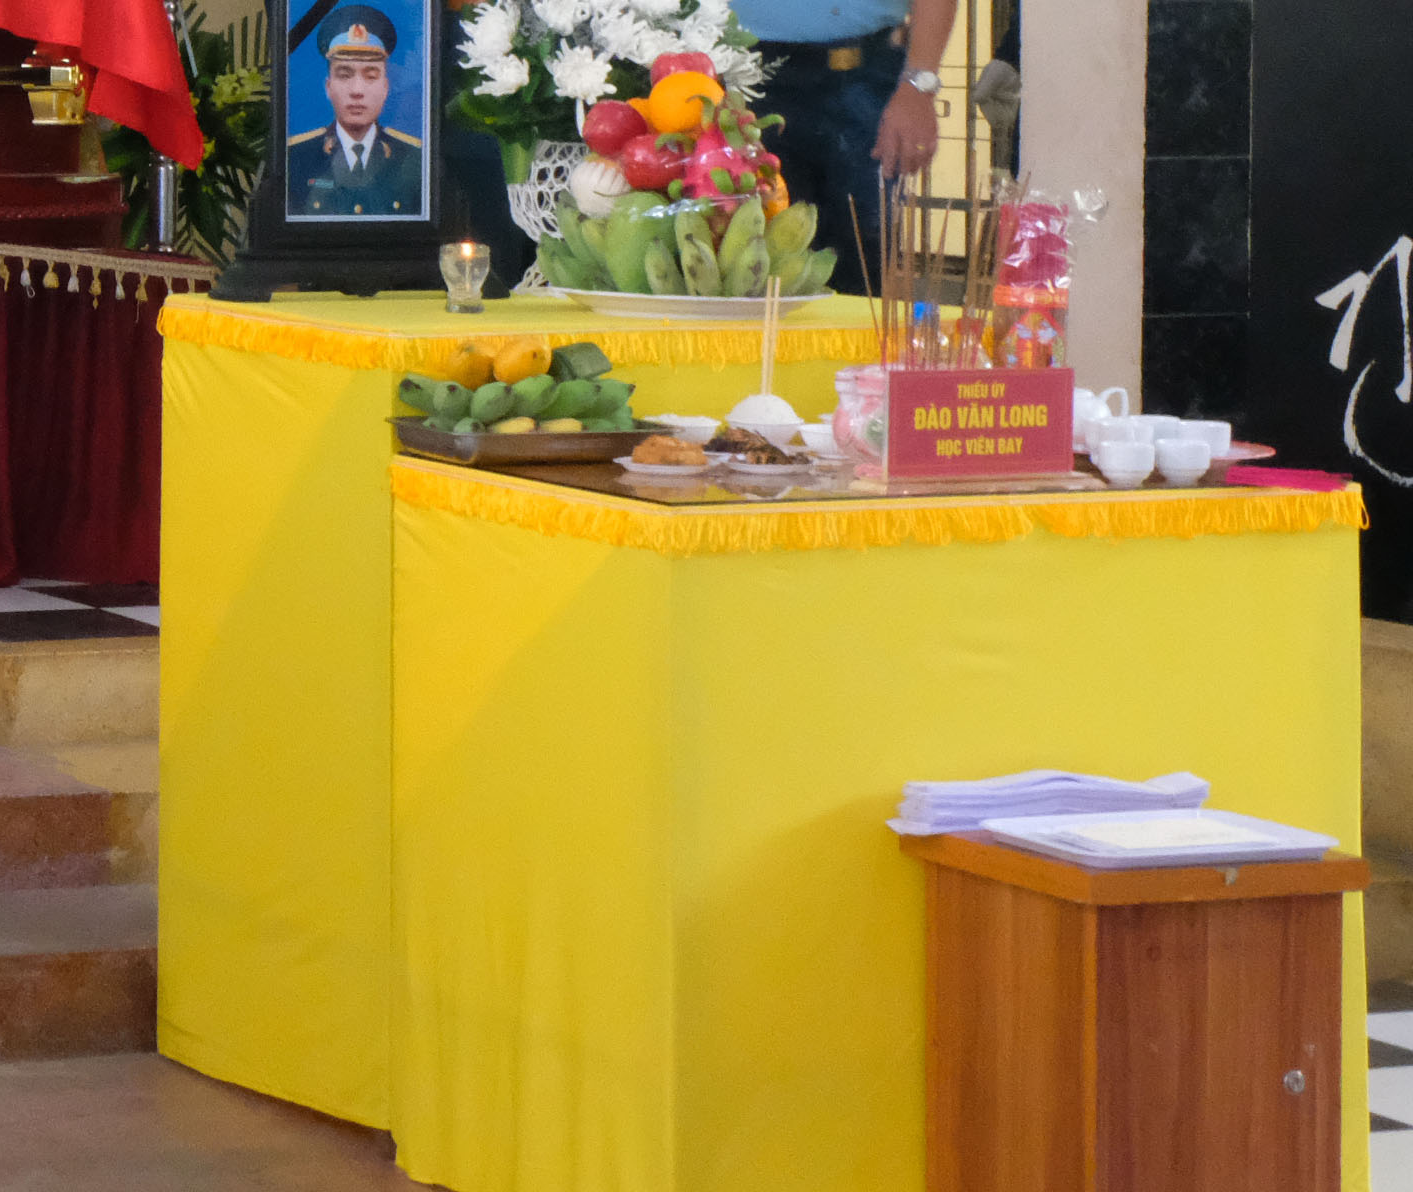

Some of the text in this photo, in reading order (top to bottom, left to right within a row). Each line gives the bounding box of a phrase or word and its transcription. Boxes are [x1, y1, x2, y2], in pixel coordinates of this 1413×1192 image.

[957, 379, 990, 399] THIẾU
[914, 401, 1049, 430] ĐÀO VĂN LONG
[936, 438, 963, 459] HỌC
[997, 436, 1024, 455] BAY
